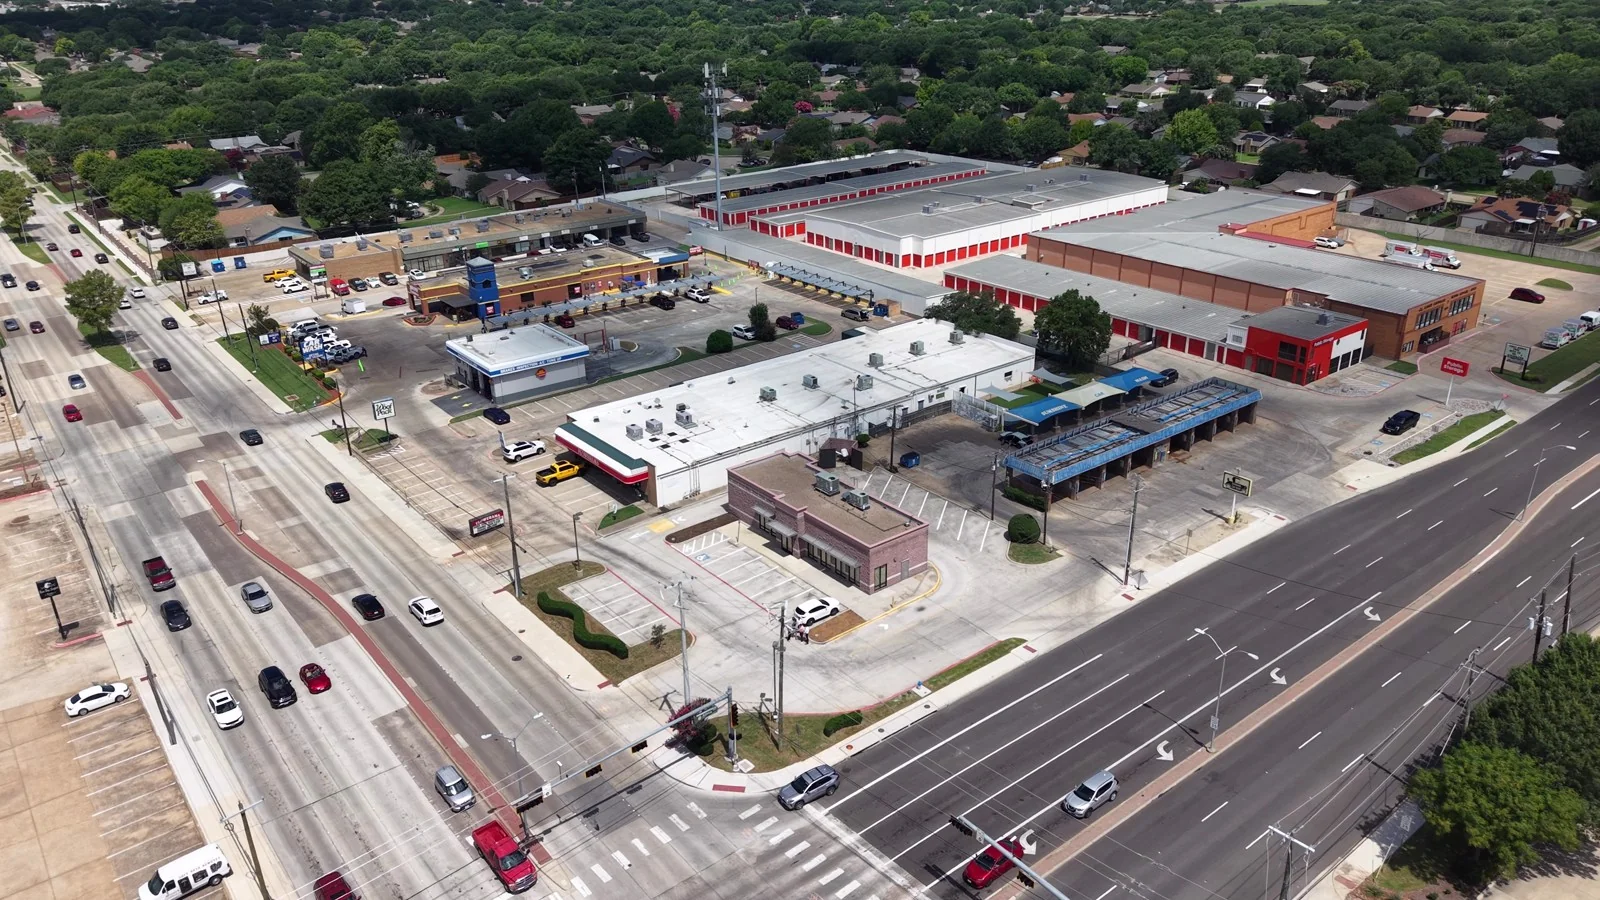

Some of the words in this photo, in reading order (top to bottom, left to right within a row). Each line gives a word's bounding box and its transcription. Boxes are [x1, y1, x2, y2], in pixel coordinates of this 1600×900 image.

[304, 339, 320, 347] CAR
[303, 343, 322, 353] WASH
[1443, 364, 1464, 374] Storage
[1447, 361, 1463, 369] Public
